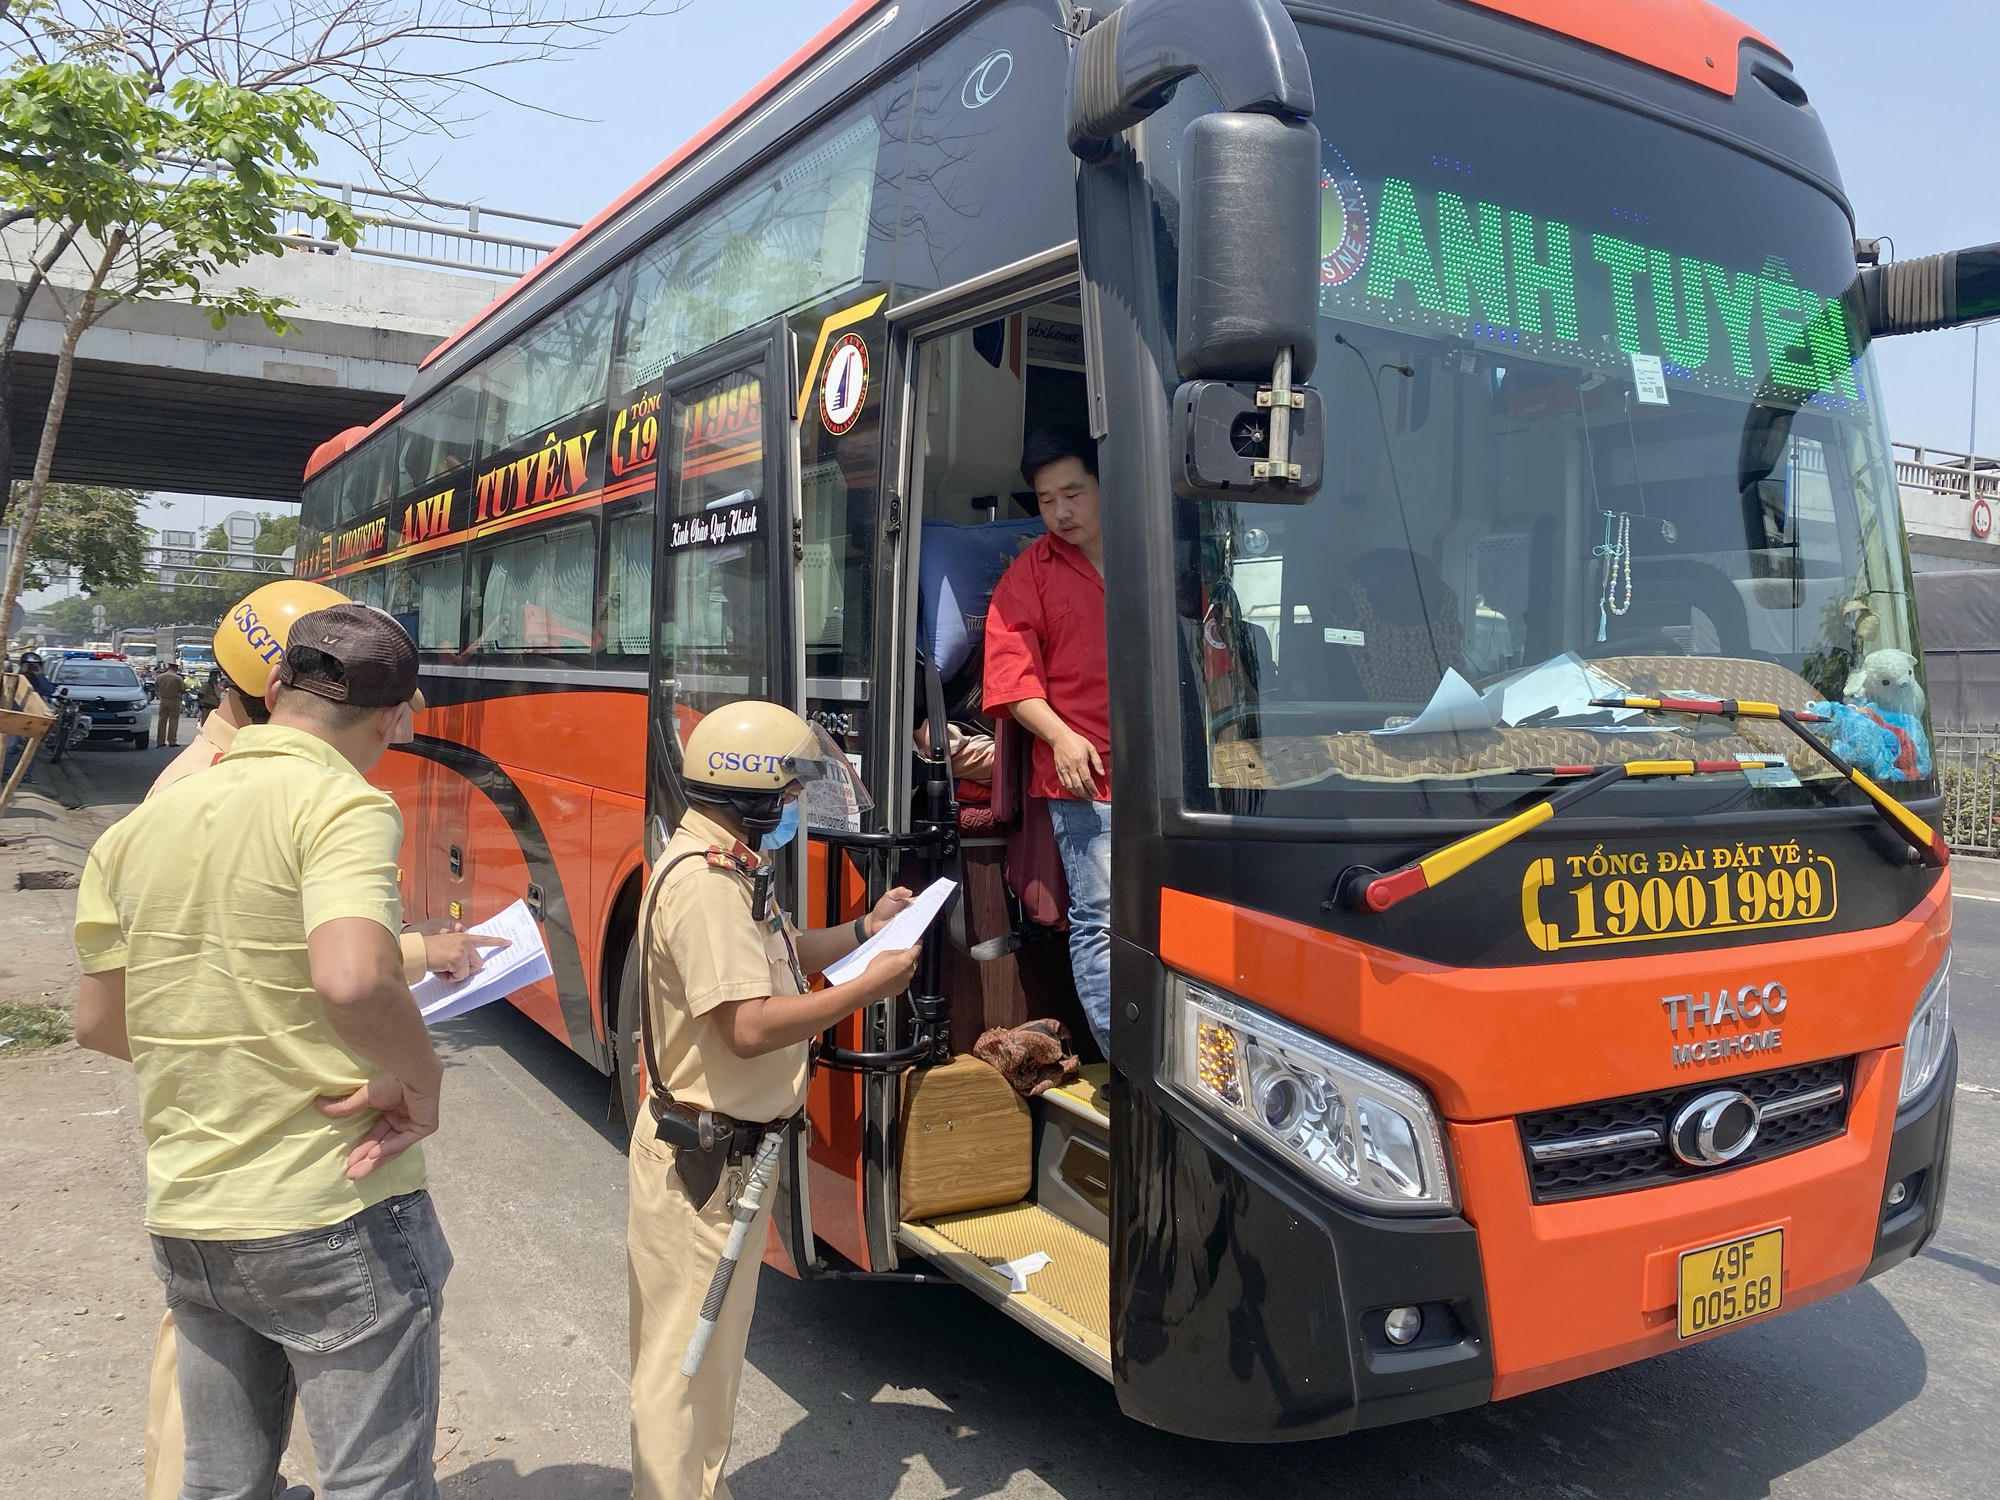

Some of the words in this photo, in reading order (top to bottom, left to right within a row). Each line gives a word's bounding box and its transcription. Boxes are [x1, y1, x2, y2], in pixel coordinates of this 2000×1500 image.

[1366, 176, 1579, 341] ANH
[1592, 232, 1860, 401] TUYÊN
[335, 516, 387, 563] LIMOUSINE
[396, 487, 456, 548] ANH
[474, 429, 597, 524] TUYÊN
[726, 505, 758, 537] Khách
[233, 603, 285, 665] CSGT
[707, 751, 782, 774] CSGT
[1566, 843, 1649, 879] TỔNG
[1657, 844, 1707, 873] ĐÀI
[1713, 844, 1764, 874] ĐẶT
[1569, 867, 1824, 939] 19001999
[1661, 981, 1788, 1031] THACO
[1673, 1028, 1782, 1066] MOBIHOME
[1712, 1241, 1755, 1284] 49F
[1693, 1276, 1772, 1330] 005.68
